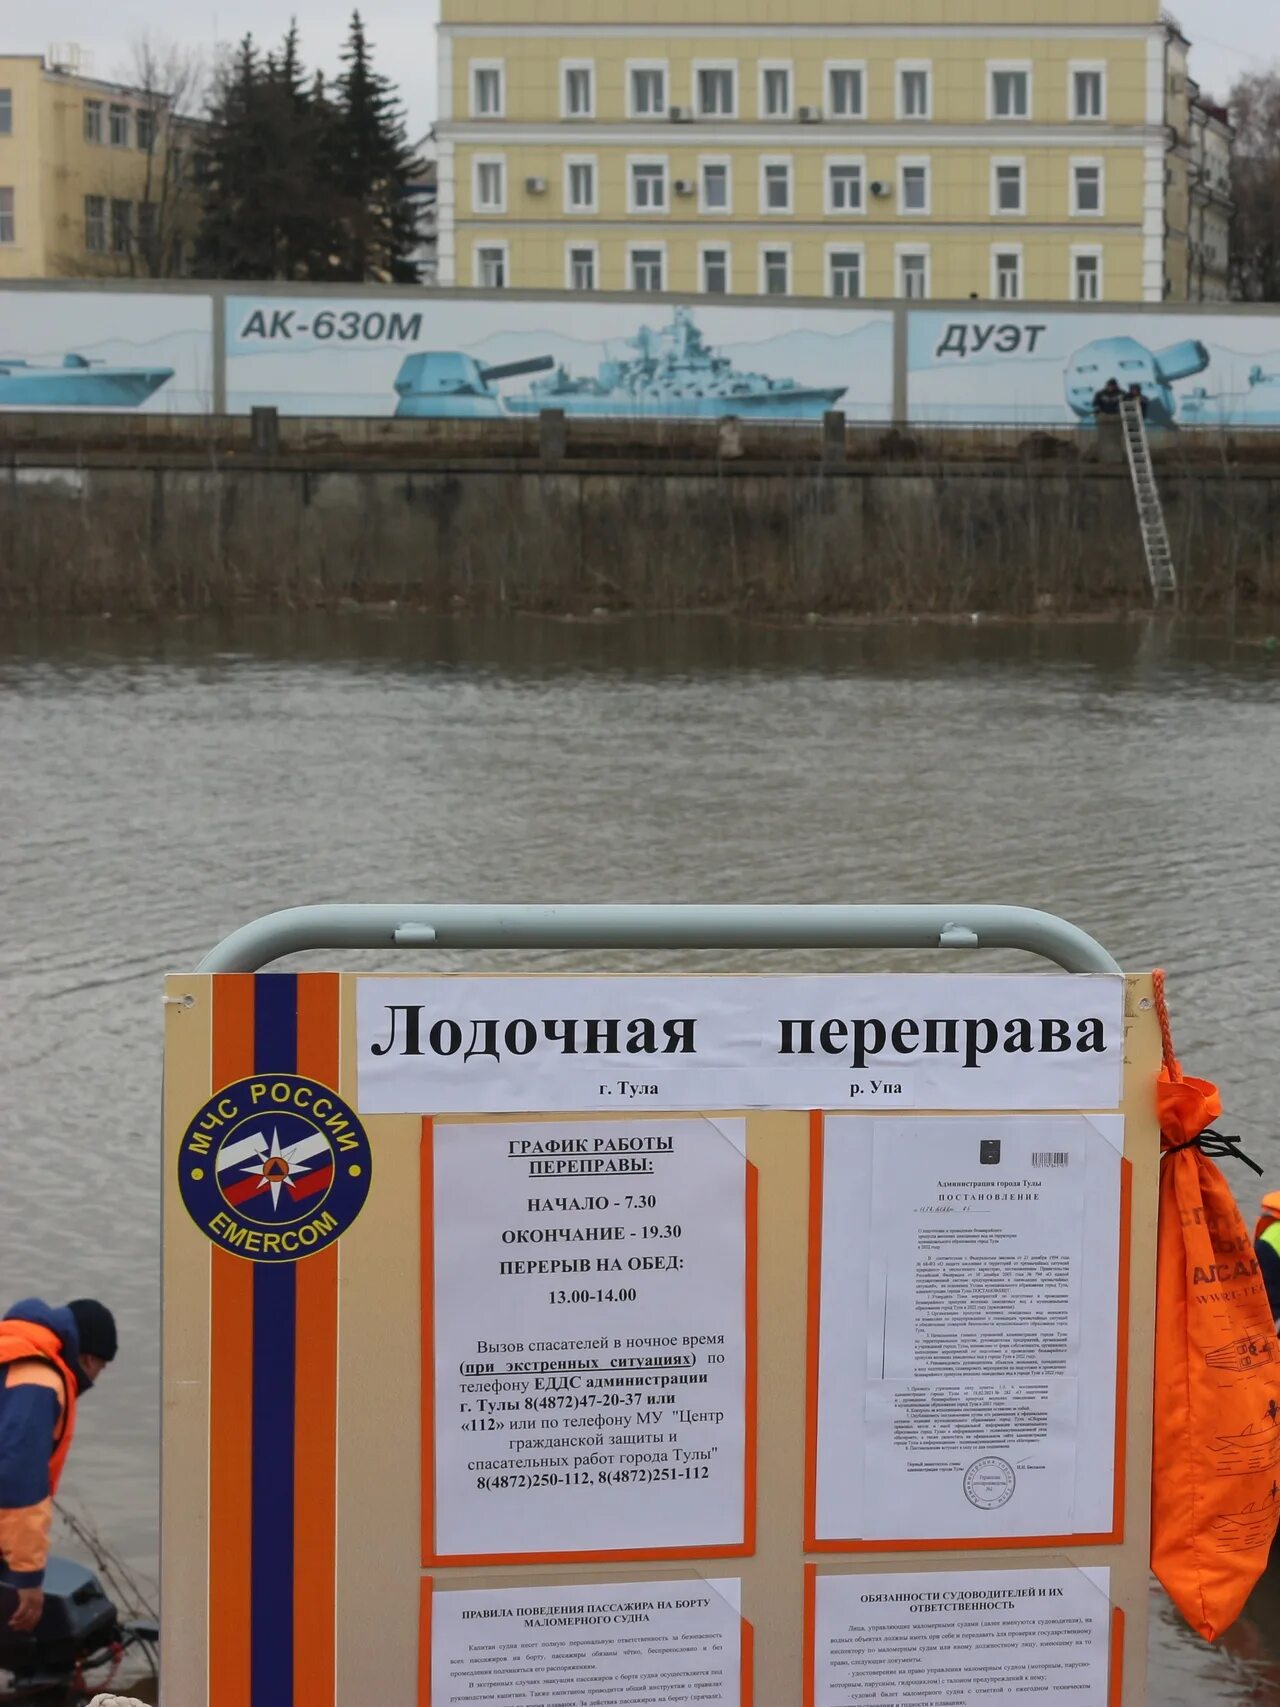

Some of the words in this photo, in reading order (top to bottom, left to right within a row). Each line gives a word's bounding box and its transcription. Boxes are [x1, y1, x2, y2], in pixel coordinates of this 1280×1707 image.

[241, 310, 423, 341] АК-630М
[936, 324, 1047, 357] ДУЭТ
[371, 1004, 698, 1063] Лодочная
[777, 1016, 1108, 1069] переправа
[598, 1085, 612, 1096] г.
[617, 1080, 658, 1098] Тула
[849, 1082, 866, 1098] р.
[870, 1080, 902, 1094] Упа
[188, 1099, 238, 1155] МЧС
[250, 1082, 360, 1152] РОССИИ
[508, 1138, 588, 1158] ГРАФИК
[593, 1136, 673, 1155] РАБОТЫ
[529, 1157, 653, 1178] ПЕРЕПРАВЫ:
[937, 1179, 995, 1190] Администрация
[995, 1179, 1021, 1190] города
[1022, 1179, 1042, 1190] Тулы
[527, 1196, 609, 1212] НАЧАЛО
[624, 1194, 657, 1209] 7.30
[937, 1193, 1039, 1202] ПОСТАНОВЛЕНИЕ
[208, 1211, 339, 1253] EMERCOM
[501, 1226, 625, 1243] ОКОНЧАНИЕ
[642, 1224, 682, 1239] 19.30
[499, 1258, 591, 1275] ПЕРЕРЫВ
[596, 1257, 622, 1272] НА
[627, 1255, 684, 1271] ОБЕД:
[549, 1288, 637, 1304] 13.00-14.00
[476, 1338, 524, 1355] Вызов
[527, 1336, 609, 1353] спасателей
[613, 1336, 622, 1350] в
[625, 1336, 678, 1349] ночное
[681, 1332, 725, 1349] время
[458, 1361, 495, 1377] (при
[507, 1359, 599, 1375] экстренных
[609, 1353, 697, 1371] ситуациях)
[707, 1353, 726, 1365] по
[460, 1378, 529, 1395] телефону
[534, 1375, 582, 1392] ЕДДС
[585, 1374, 708, 1388] администрации
[459, 1402, 471, 1413] г.
[476, 1398, 520, 1414] Тулы
[523, 1393, 642, 1411] 8(4872)47-20-37
[646, 1394, 676, 1405] или
[460, 1418, 505, 1431] «112»
[508, 1419, 536, 1430] или
[540, 1418, 559, 1429] по
[564, 1413, 632, 1430] телефону
[635, 1411, 663, 1425] МУ
[508, 1433, 604, 1451] гражданской
[608, 1432, 664, 1447] защиты
[668, 1432, 677, 1443] и
[466, 1455, 569, 1471] спасательных
[573, 1451, 613, 1469] работ
[618, 1450, 668, 1466] города
[672, 1446, 718, 1464] Тулы"
[476, 1472, 594, 1490] 8(4872)250-112,
[597, 1466, 709, 1485] 8(4872)251-112
[859, 1592, 940, 1604] ОБЯЗАННОСТИ
[941, 1588, 1036, 1600] СУДОВОДИТЕЛЕЙ
[1037, 1588, 1046, 1597] И
[1048, 1587, 1063, 1596] ИХ
[908, 1600, 1015, 1612] ОТВЕТСТВЕННОСТЬ
[461, 1608, 513, 1619] ПРАВИЛА
[515, 1605, 585, 1617] ПОВЕДЕНИЯ
[586, 1601, 654, 1613] ПАССАЖИРА
[656, 1600, 673, 1611] НА
[675, 1598, 711, 1609] БОРТУ
[523, 1615, 612, 1627] МАЛОМЕРНОГО
[612, 1613, 650, 1624] СУДНА
